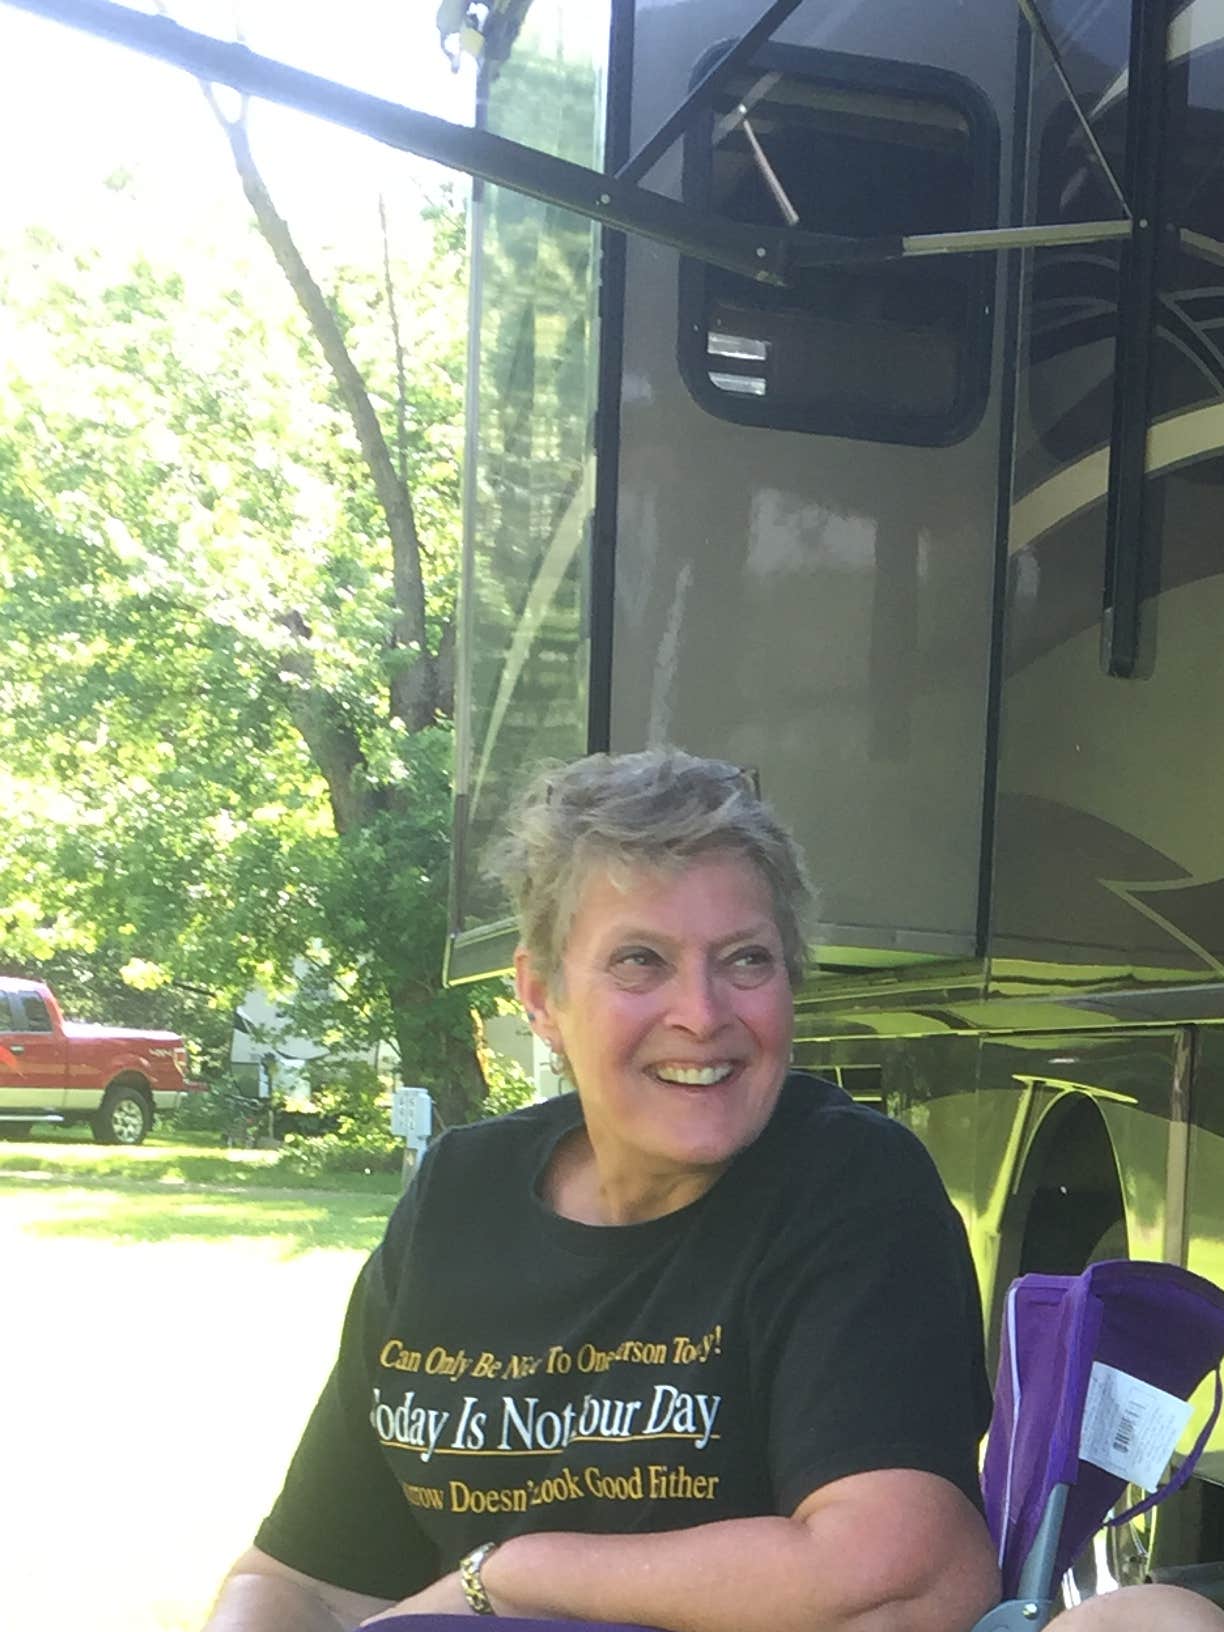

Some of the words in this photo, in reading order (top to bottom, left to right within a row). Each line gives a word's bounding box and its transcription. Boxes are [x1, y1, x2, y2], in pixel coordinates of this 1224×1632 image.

[380, 1339, 422, 1373] Can
[425, 1346, 472, 1382] Only
[471, 1352, 502, 1378] Be
[545, 1345, 572, 1374] To
[370, 1388, 449, 1462] oday
[452, 1396, 487, 1450] Is
[497, 1396, 576, 1450] Not
[577, 1393, 643, 1438] our
[643, 1384, 722, 1449] Day
[584, 1465, 644, 1500] Good
